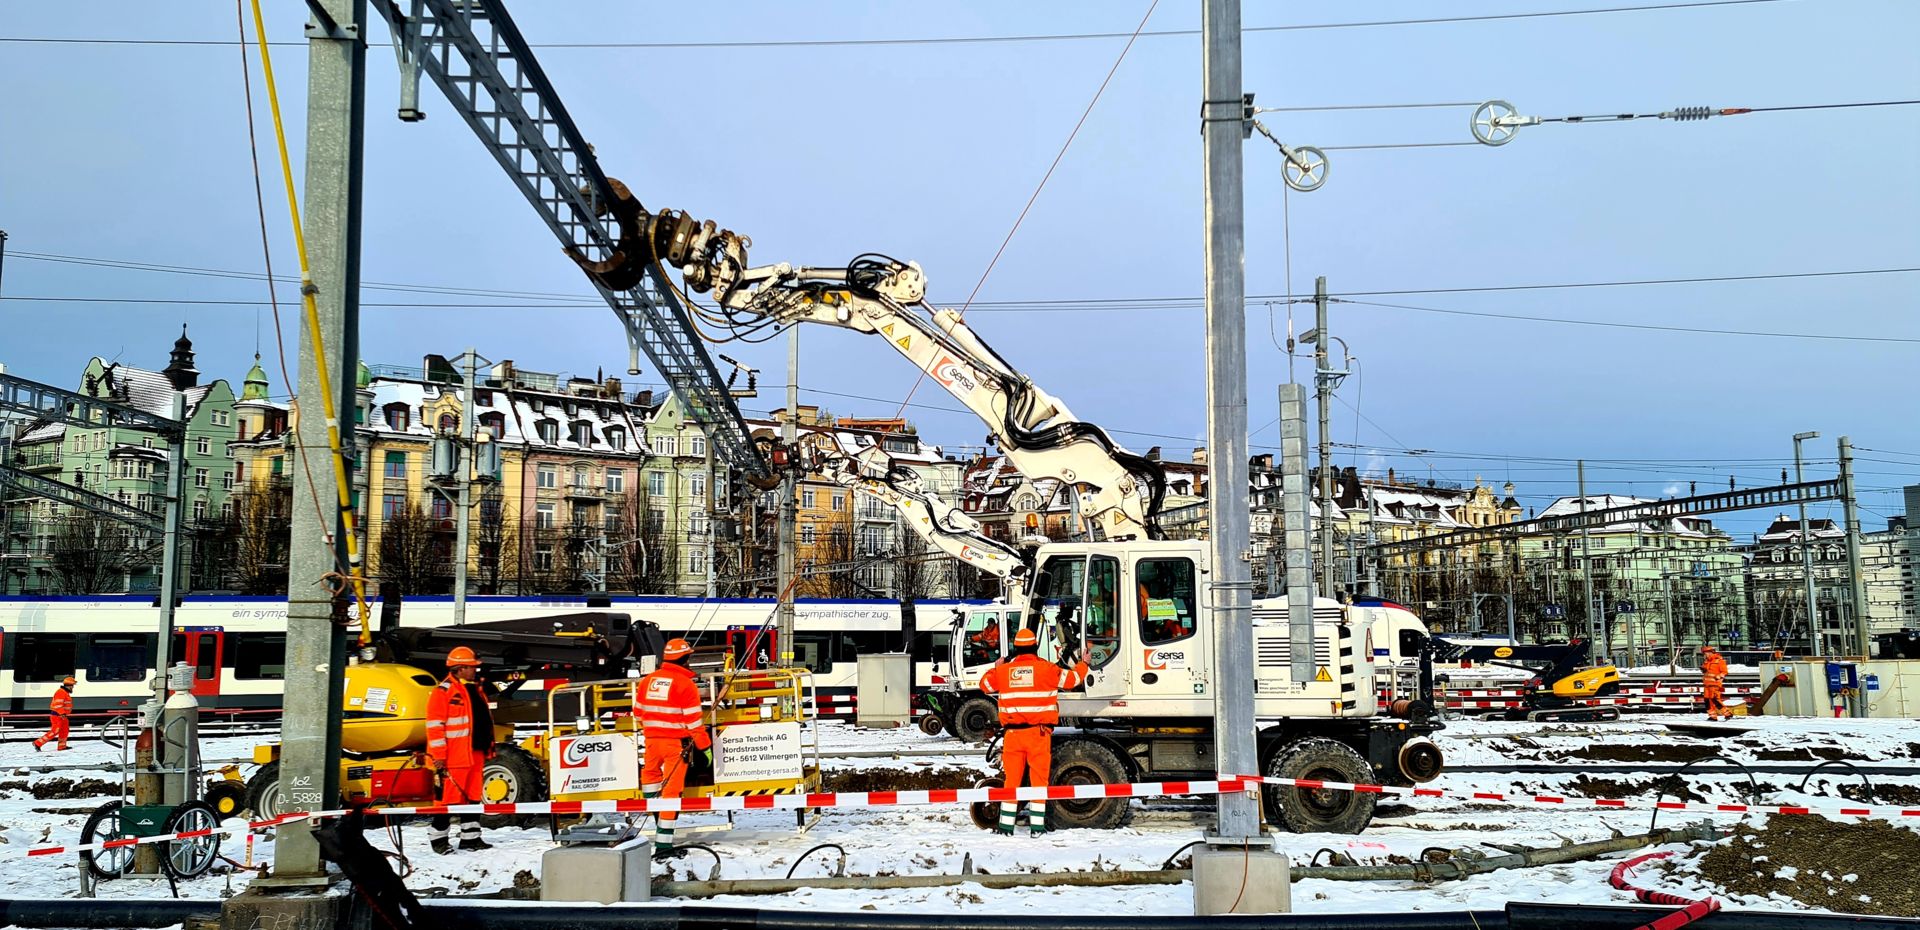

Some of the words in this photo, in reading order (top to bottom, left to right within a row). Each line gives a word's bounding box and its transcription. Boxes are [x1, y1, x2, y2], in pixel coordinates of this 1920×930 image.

[950, 368, 975, 391] sersa
[232, 608, 250, 618] ein
[253, 609, 288, 622] symp
[800, 608, 870, 620] sympathischer
[871, 611, 891, 621] zug.
[1157, 652, 1184, 660] sersa
[723, 737, 744, 745] Sersa
[746, 735, 773, 743] Technik
[776, 734, 788, 742] AG
[577, 742, 612, 754] sersa
[723, 746, 768, 755] Nordstrasse
[723, 756, 735, 764] CH
[740, 754, 757, 763] 5612
[759, 753, 799, 763] Villmergen
[724, 767, 800, 778] www.rhomberg-sersa.ch
[291, 776, 312, 786] 102
[293, 792, 322, 805] 5828
